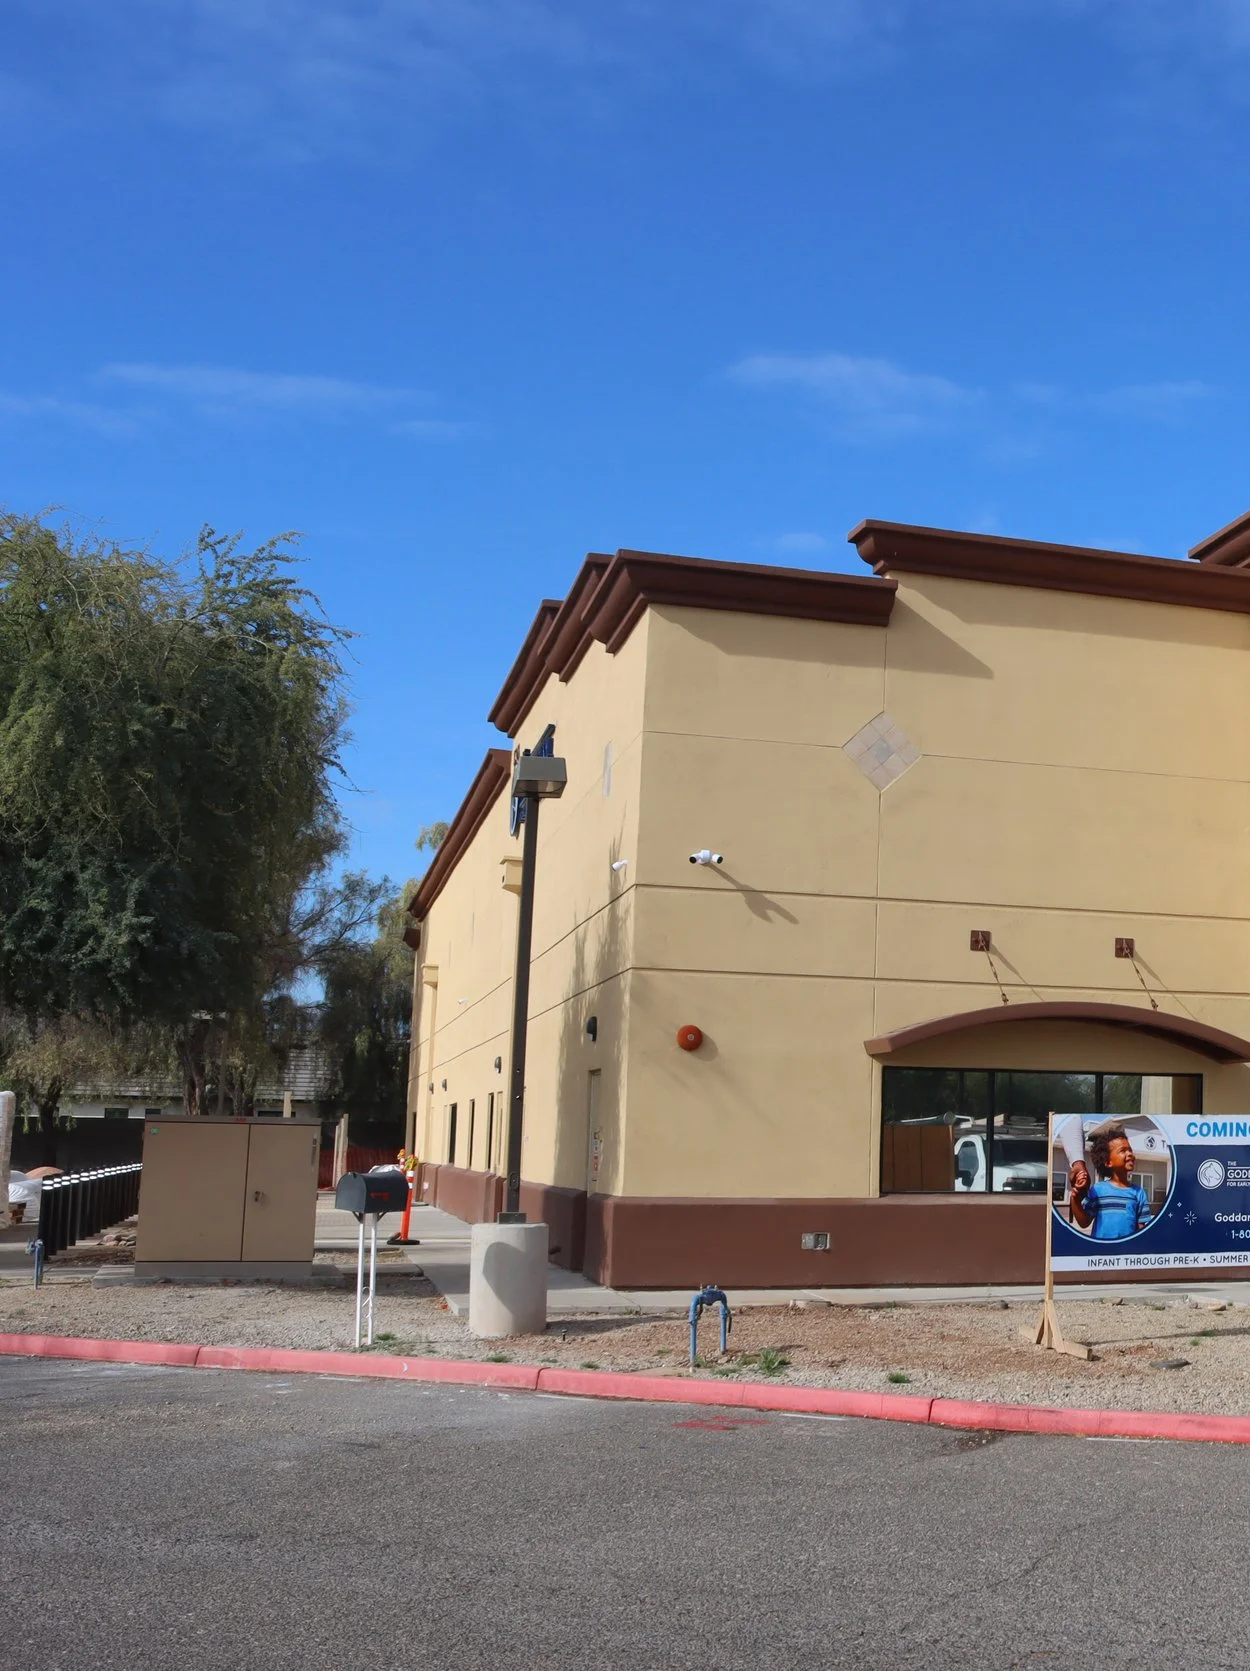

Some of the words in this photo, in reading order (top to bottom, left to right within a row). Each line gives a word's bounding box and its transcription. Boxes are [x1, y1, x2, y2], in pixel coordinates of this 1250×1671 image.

[1087, 1257, 1121, 1267] INFANT
[1124, 1256, 1170, 1266] THROUGH
[1173, 1256, 1200, 1265] PRE-K
[1209, 1254, 1249, 1264] SUMMER
